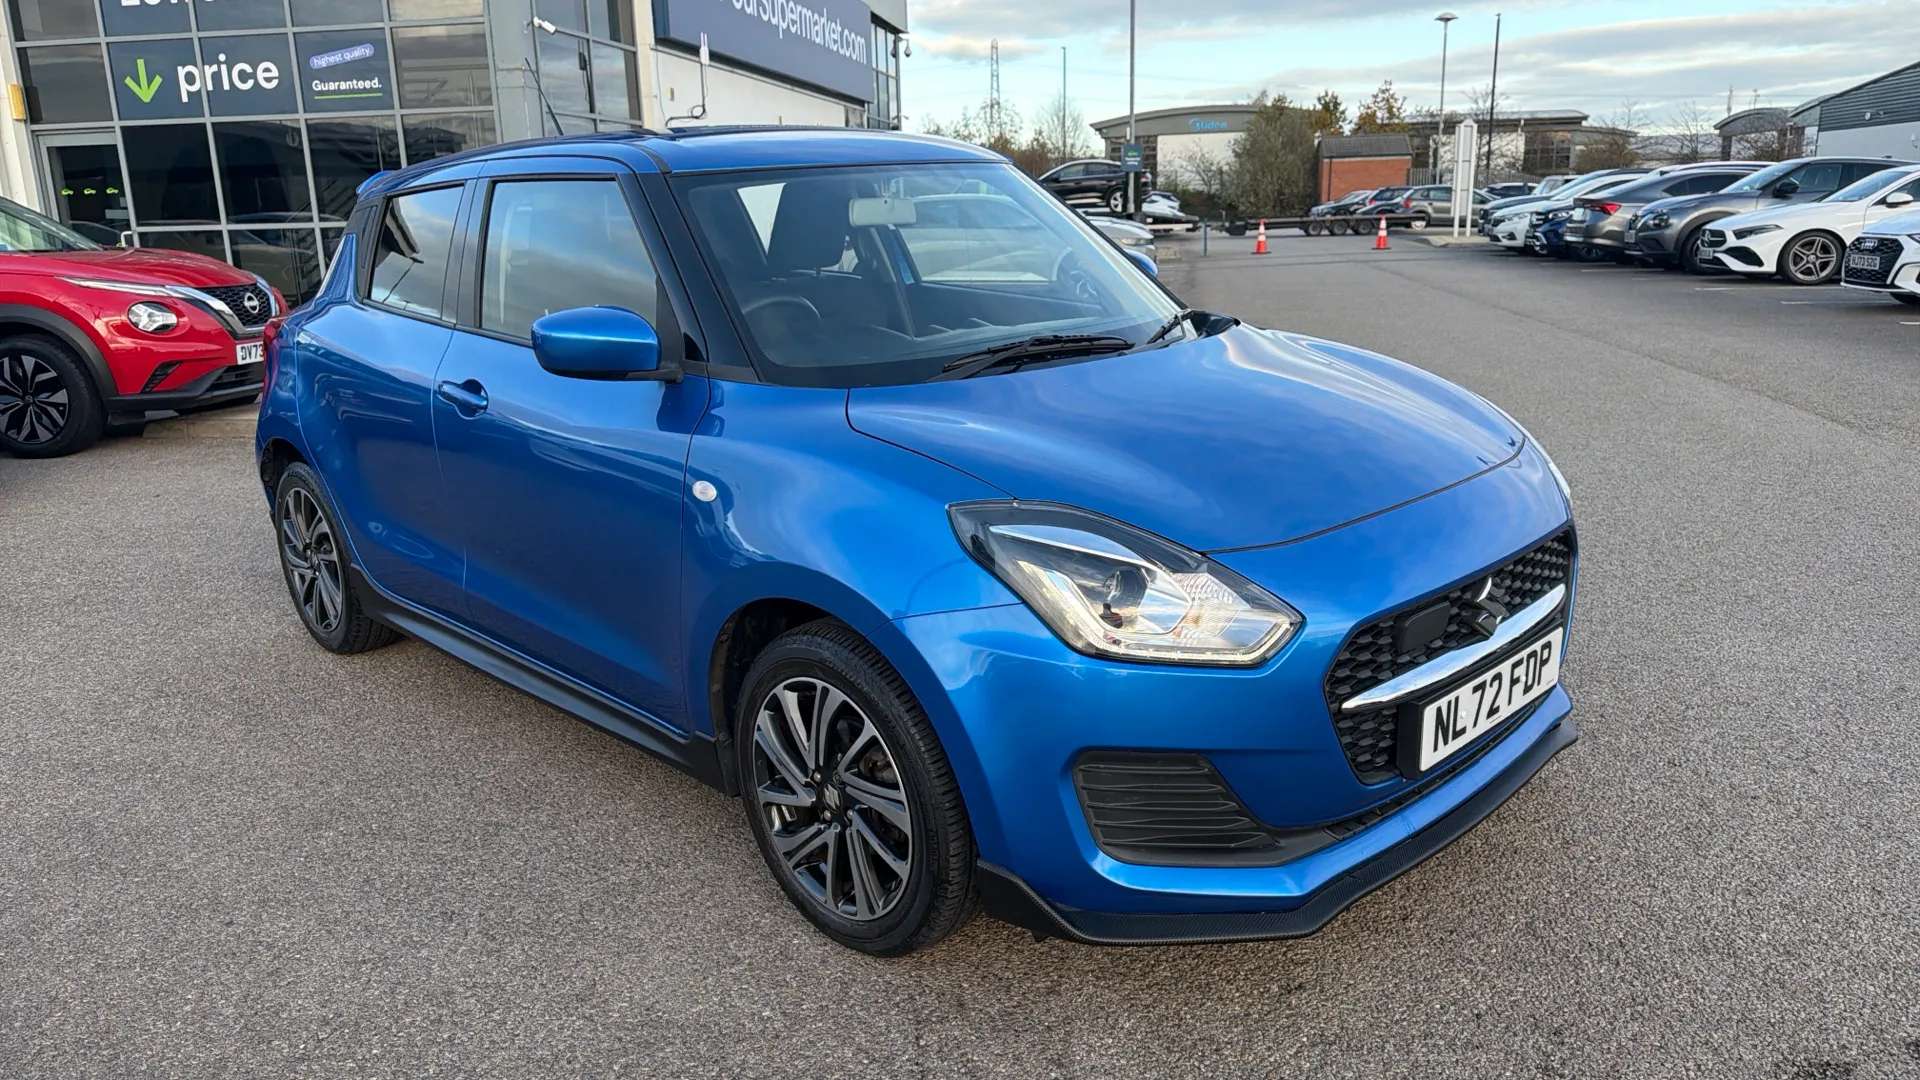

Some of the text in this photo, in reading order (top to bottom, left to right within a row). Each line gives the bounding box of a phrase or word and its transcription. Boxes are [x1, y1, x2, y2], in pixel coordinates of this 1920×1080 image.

[313, 46, 371, 67] highest quality
[177, 53, 280, 103] price
[312, 77, 383, 92] Guaranteed.
[1507, 640, 1553, 706] FDP
